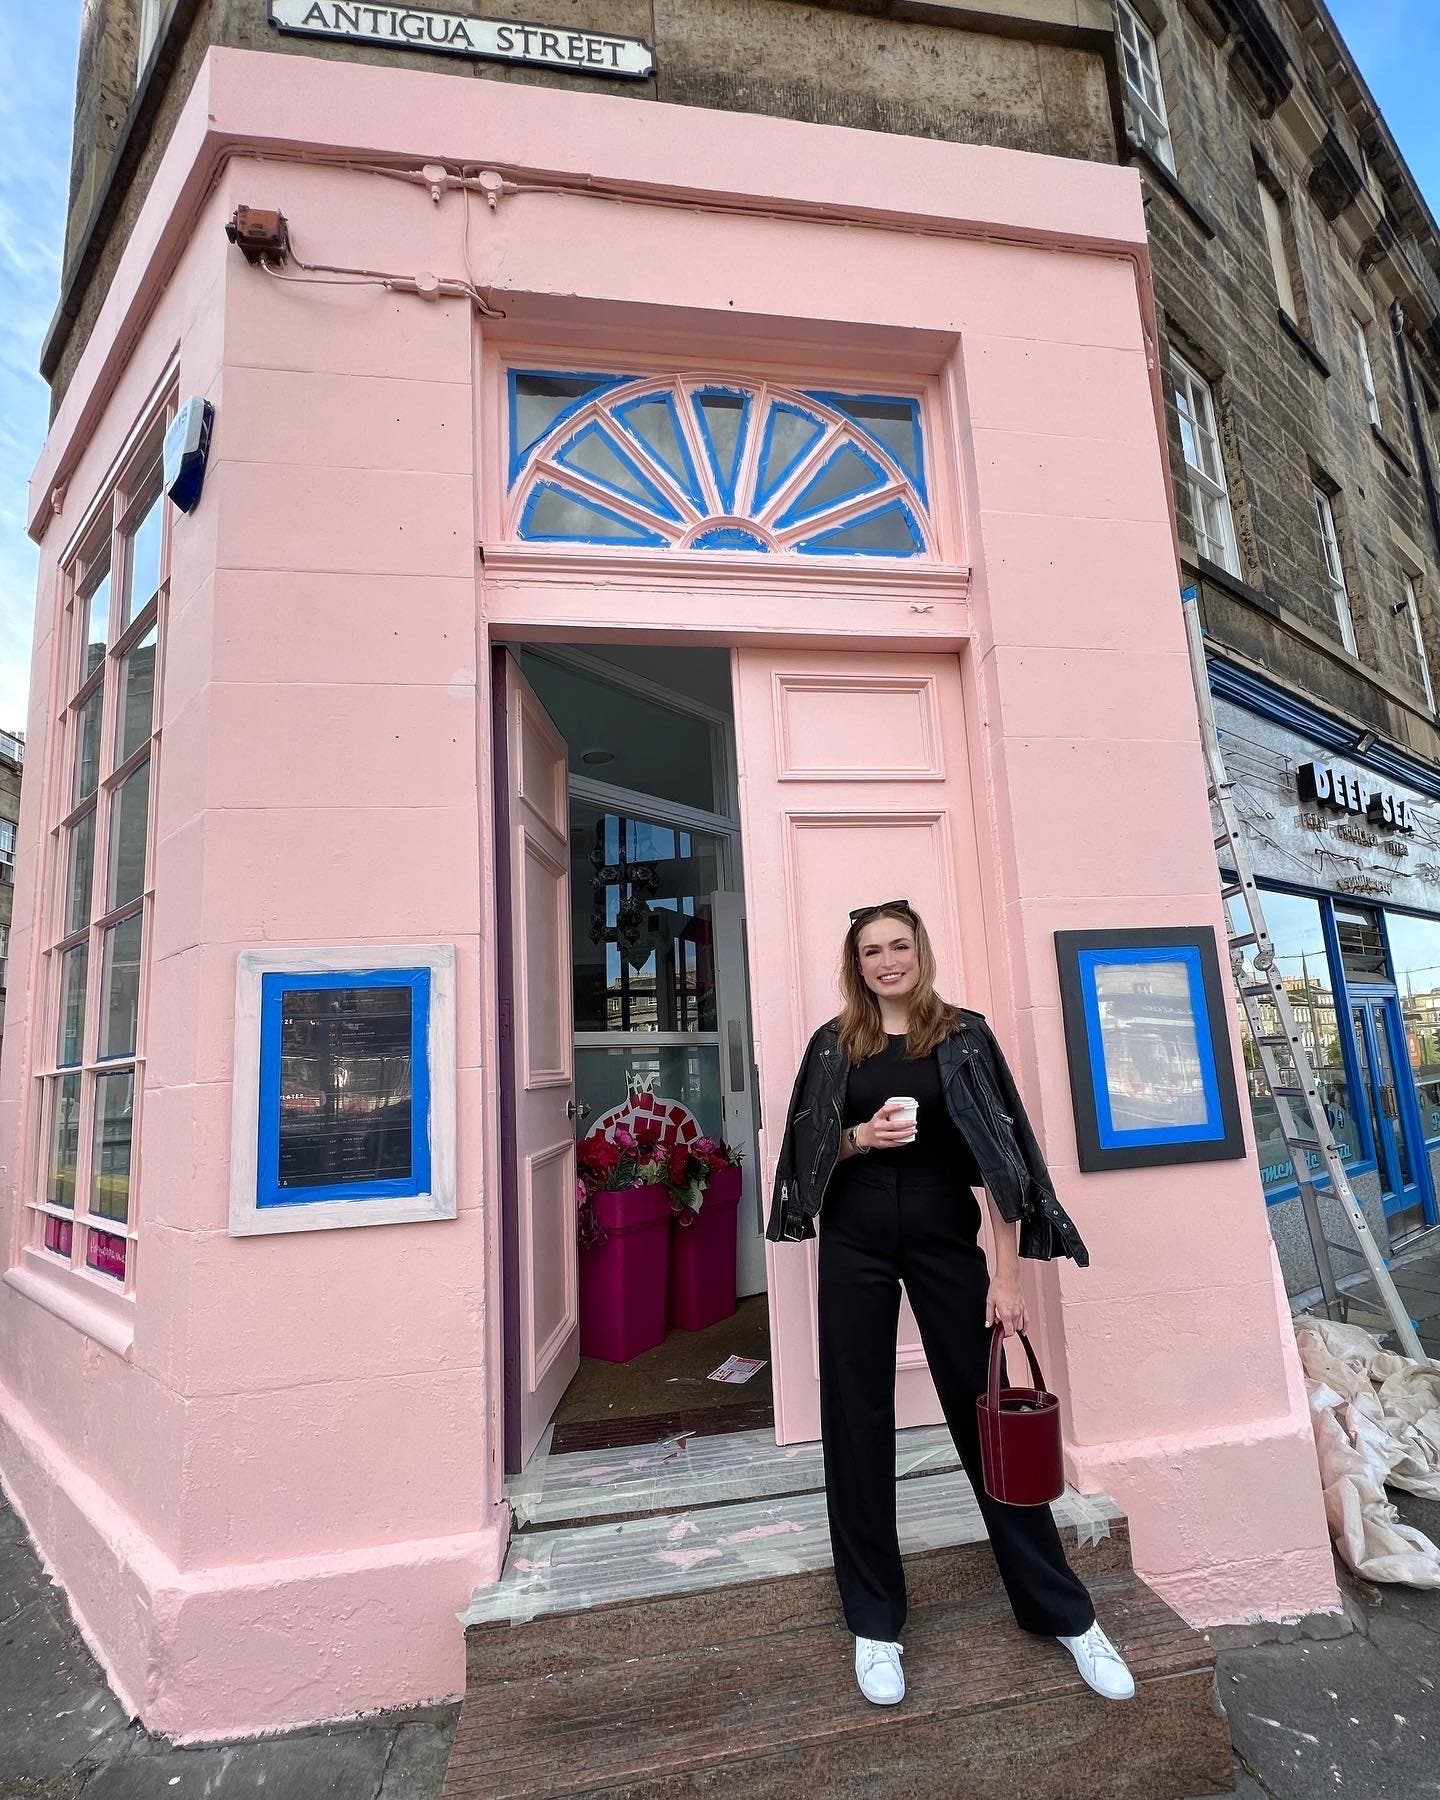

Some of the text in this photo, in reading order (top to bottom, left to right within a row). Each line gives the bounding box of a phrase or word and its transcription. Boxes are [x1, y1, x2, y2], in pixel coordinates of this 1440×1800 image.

[302, 1, 626, 68] ANTIGUA STREET
[1308, 761, 1371, 815] DEEP
[1379, 791, 1417, 832] SEA
